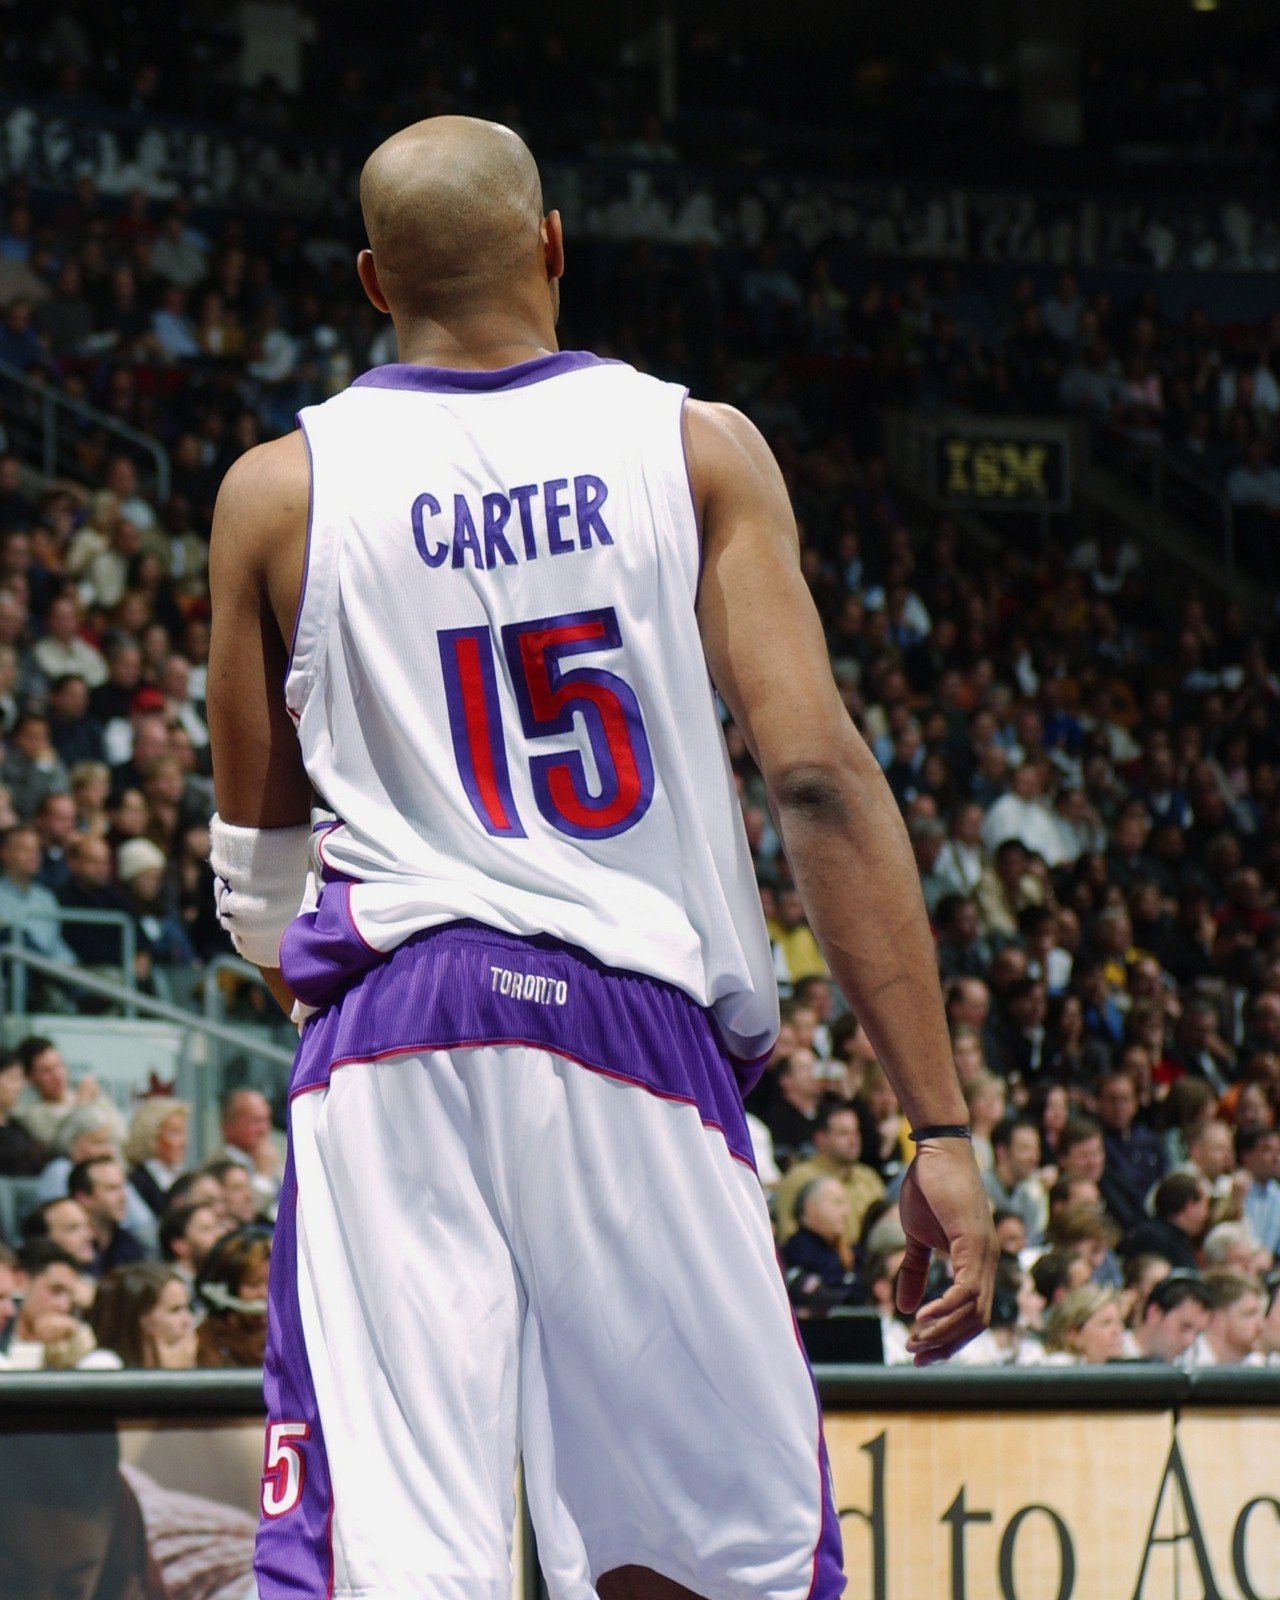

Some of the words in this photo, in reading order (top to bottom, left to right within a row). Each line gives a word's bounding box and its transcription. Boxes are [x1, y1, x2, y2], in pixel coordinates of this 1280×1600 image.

[411, 474, 615, 570] CARTER
[436, 606, 656, 840] 15
[490, 966, 568, 1006] TORONTO
[940, 1483, 1076, 1600] to
